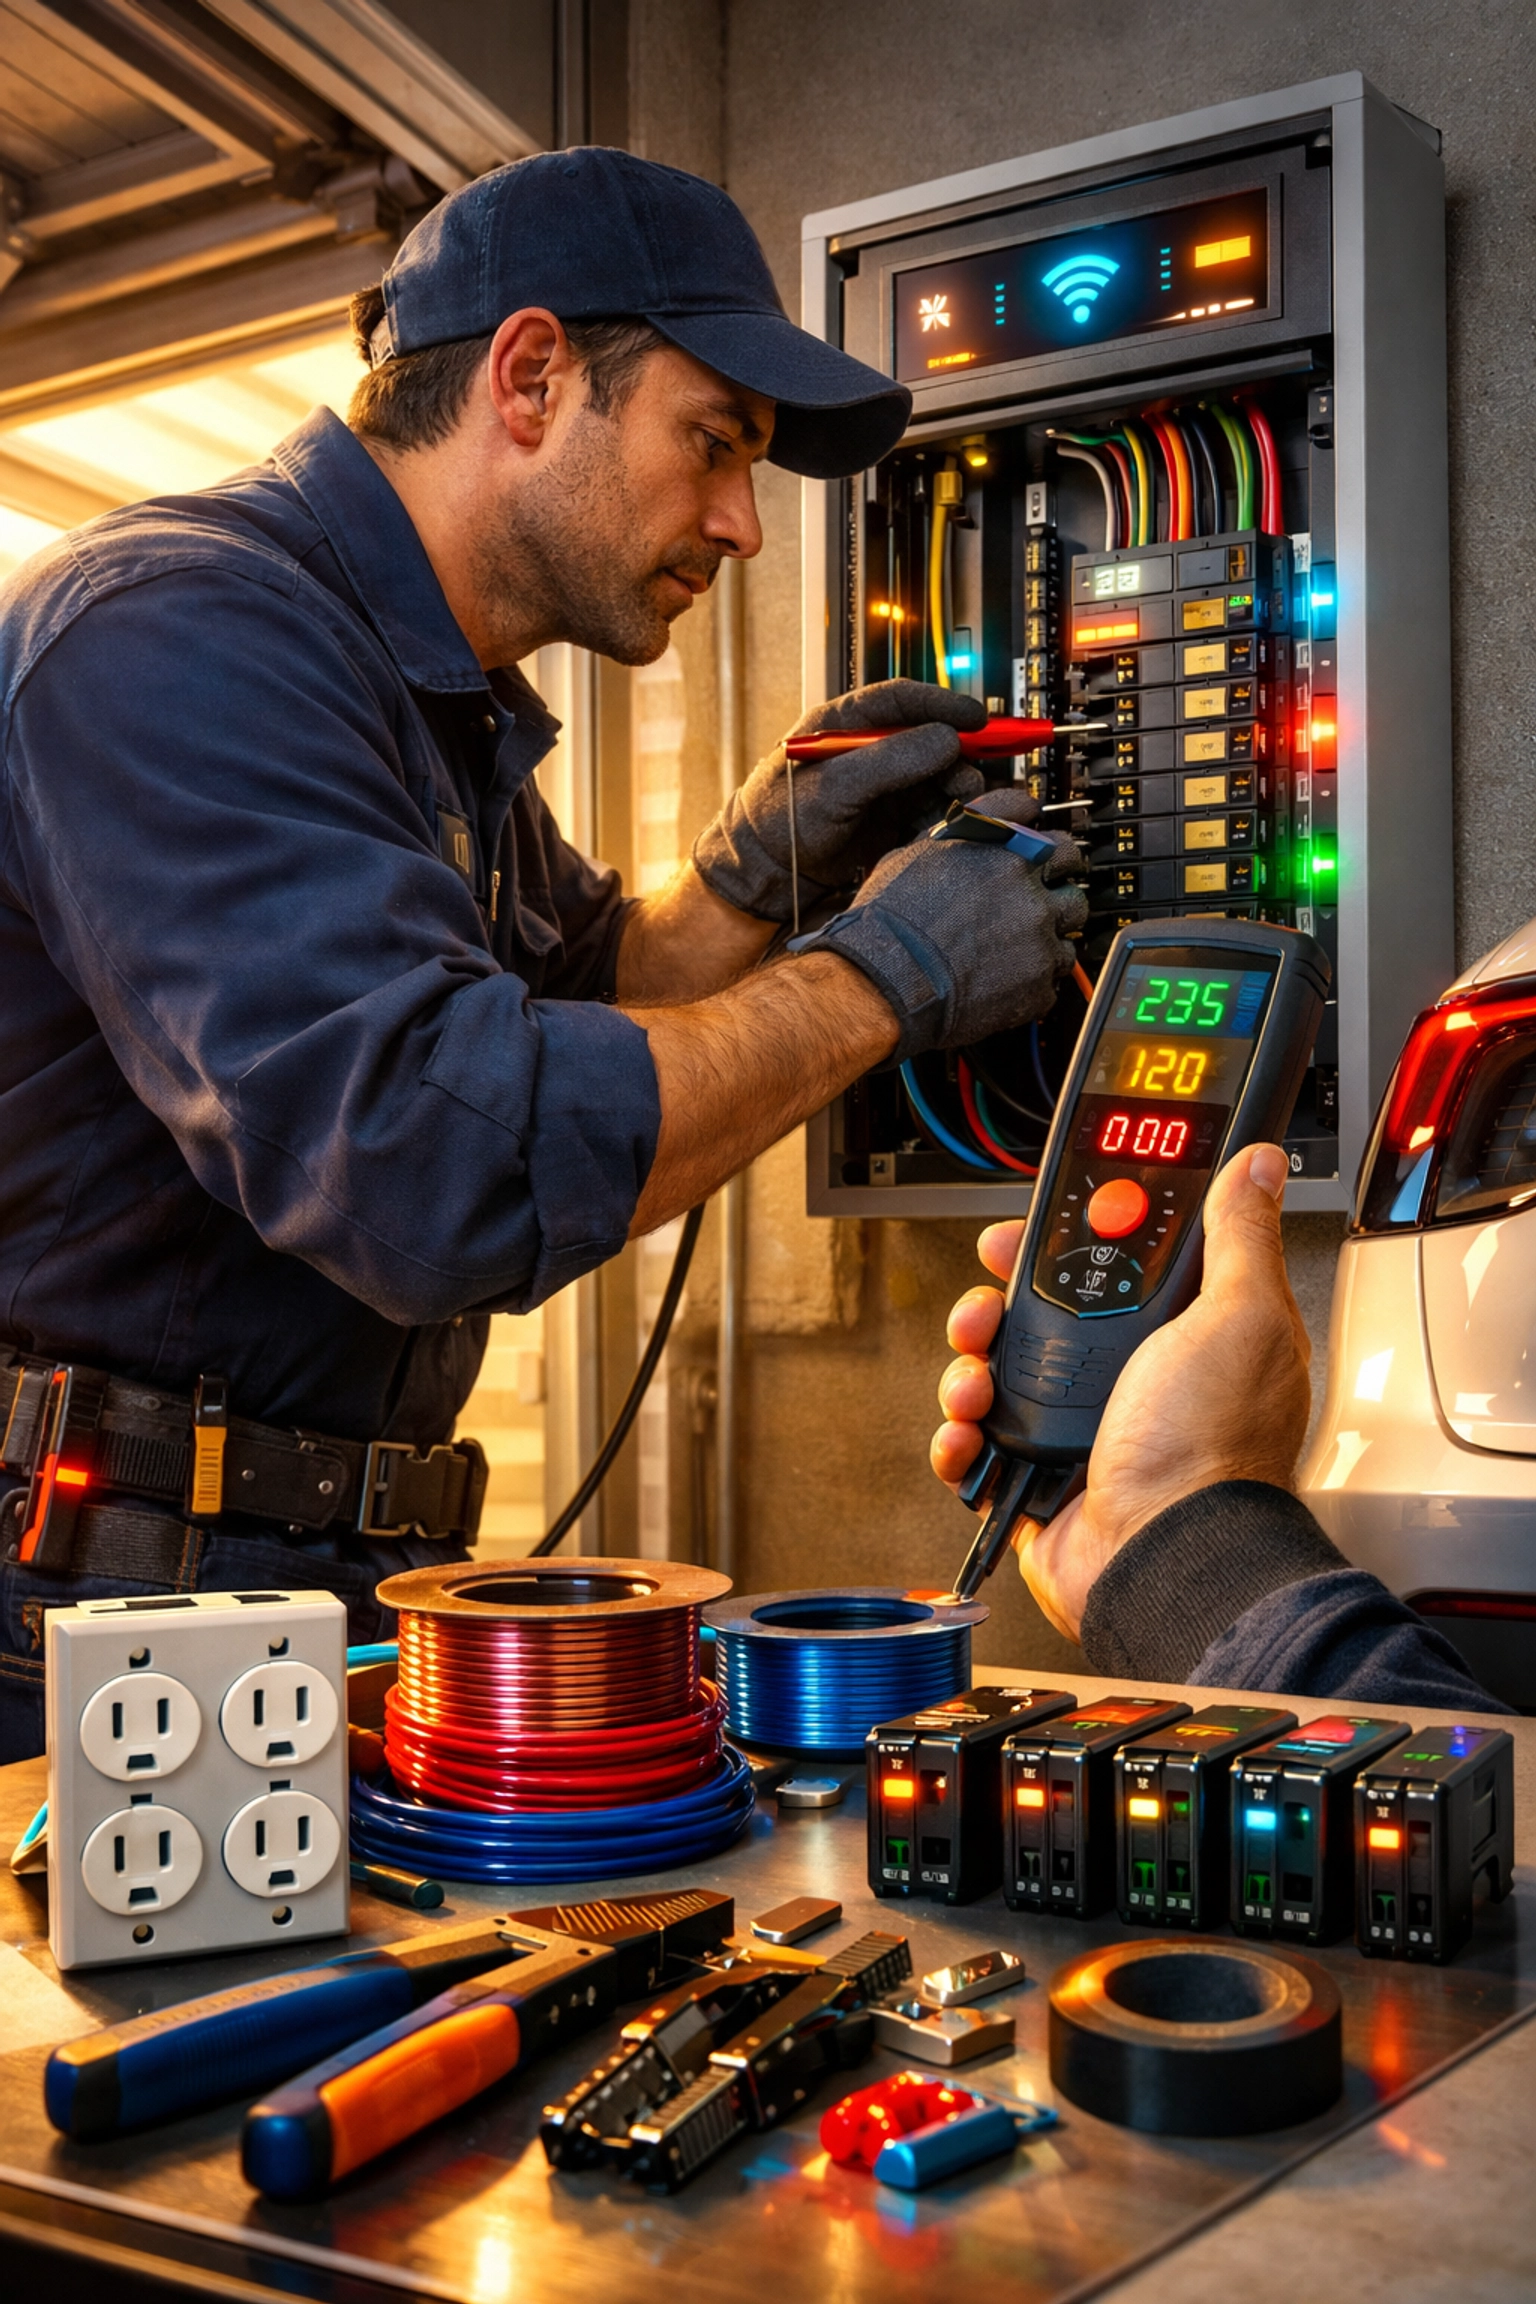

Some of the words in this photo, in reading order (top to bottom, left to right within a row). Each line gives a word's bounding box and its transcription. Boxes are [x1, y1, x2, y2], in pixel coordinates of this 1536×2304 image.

[1136, 979, 1230, 1026] 235
[1129, 1048, 1207, 1095] 120
[1101, 1115, 1188, 1158] 000
